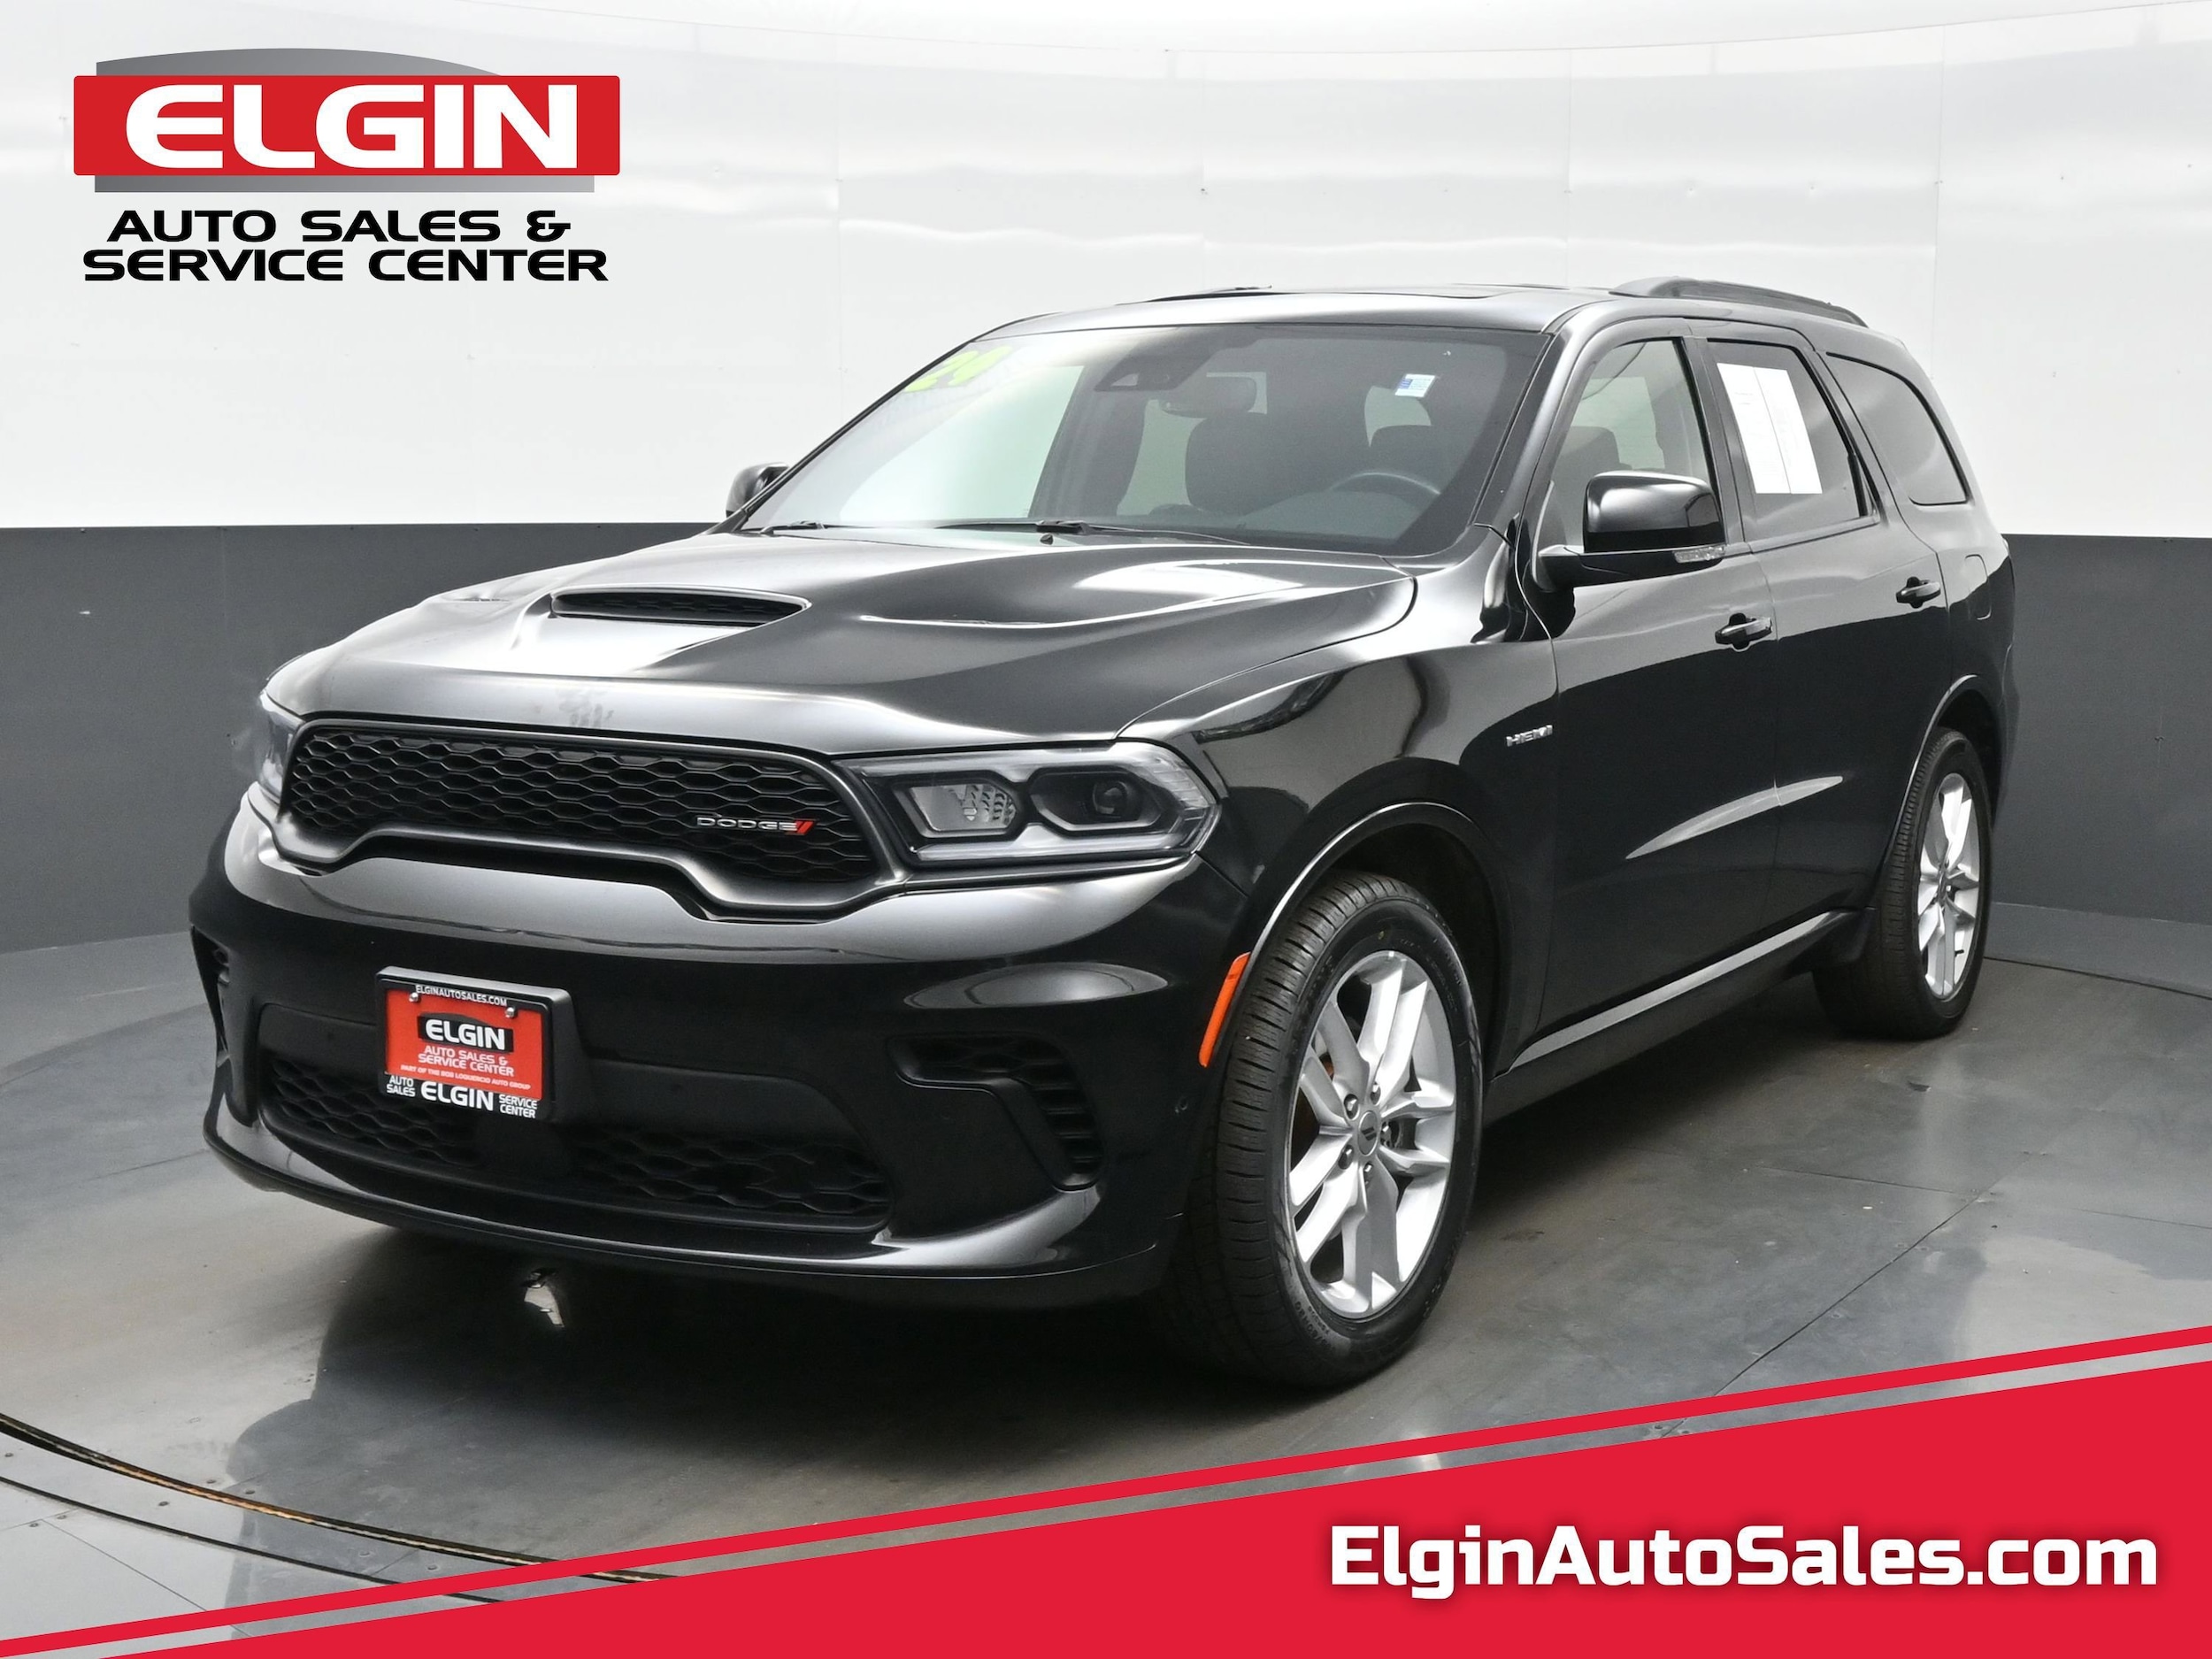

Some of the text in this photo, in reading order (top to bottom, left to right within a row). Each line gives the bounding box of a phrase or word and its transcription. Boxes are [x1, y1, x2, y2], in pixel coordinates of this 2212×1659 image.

[1506, 725, 1553, 747] HEMI
[696, 817, 797, 832] DODGE
[415, 985, 507, 1007] ELGINAUTOSALES.COM
[425, 1018, 506, 1050] ELGIN
[418, 1054, 514, 1077] SERVICE CENTER
[424, 1045, 508, 1066] AUTO SALES &
[387, 1083, 416, 1098] SALES
[388, 1075, 414, 1088] AUTO
[420, 1079, 494, 1112] ELGIN
[498, 1093, 538, 1110] SERVICE
[499, 1103, 536, 1119] CENTER
